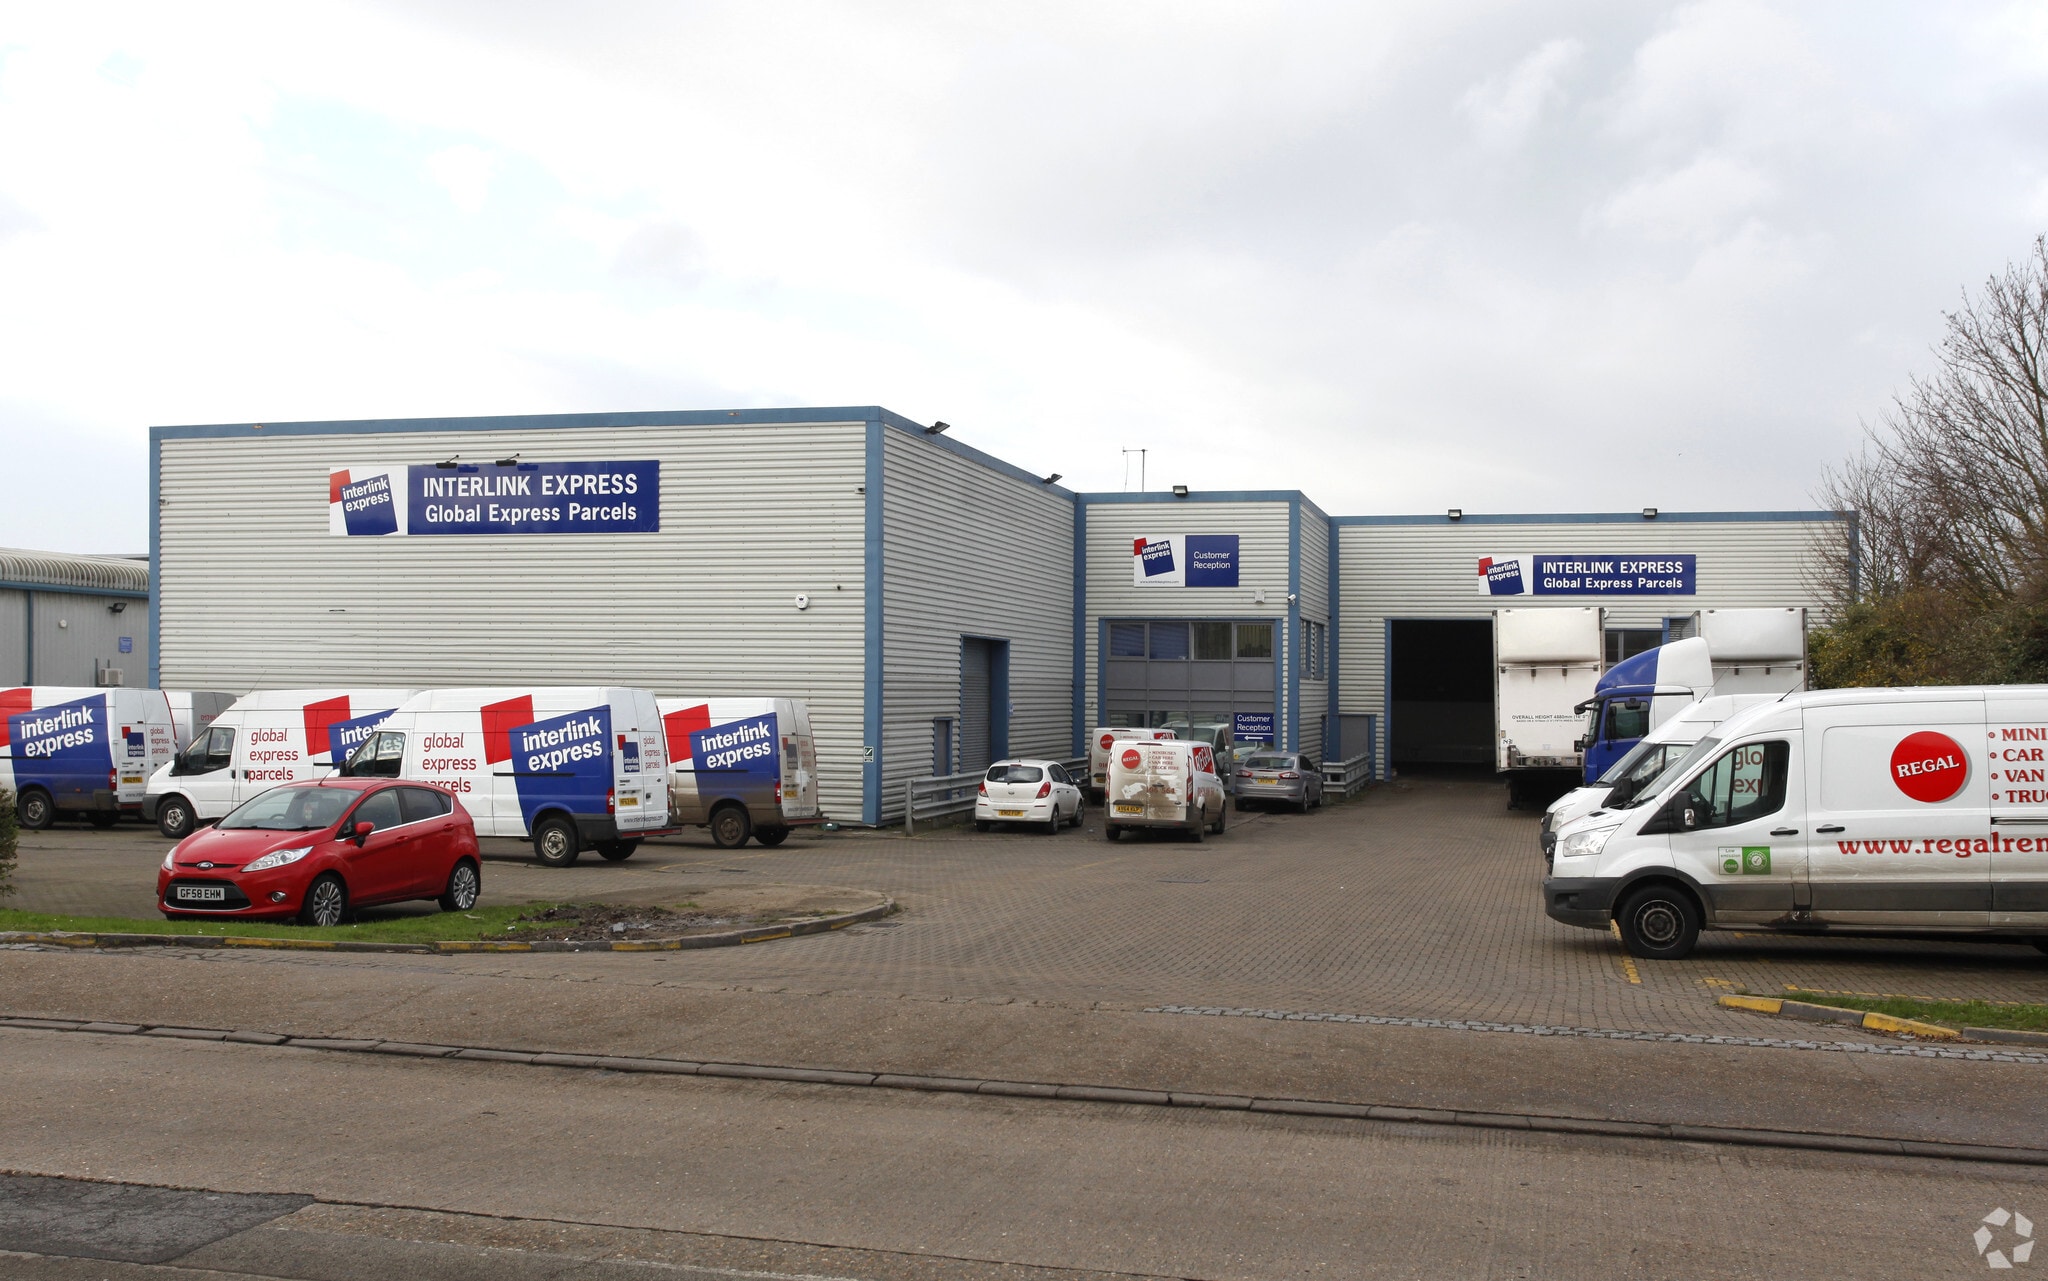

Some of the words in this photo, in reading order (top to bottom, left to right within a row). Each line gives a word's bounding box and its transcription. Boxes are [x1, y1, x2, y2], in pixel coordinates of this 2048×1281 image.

[342, 477, 389, 500] interlink
[423, 475, 531, 498] INTERLINK
[541, 473, 638, 496] EXPRESS
[345, 492, 390, 512] express
[425, 503, 480, 523] Global
[488, 503, 561, 526] Express
[568, 501, 637, 521] Parcels
[1141, 541, 1170, 555] interlink
[1143, 550, 1171, 561] express
[1193, 551, 1231, 560] Customer
[1193, 561, 1231, 570] Reception
[1486, 561, 1519, 575] interlink
[1542, 561, 1614, 574] INTERLINK
[1620, 561, 1684, 574] EXPRESS
[1489, 570, 1520, 581] express
[1543, 577, 1581, 589] Global
[1585, 577, 1633, 590] Express
[1637, 577, 1683, 588] Parcels
[20, 704, 94, 740] interlink
[1236, 714, 1271, 722] Customer
[149, 726, 165, 736] global
[522, 715, 603, 753] interlink
[1236, 723, 1271, 733] Reception
[25, 728, 94, 757] express
[150, 738, 170, 746] express
[251, 728, 288, 746] global
[423, 732, 464, 753] global
[700, 721, 771, 753] interlink
[151, 746, 169, 755] parcels
[249, 750, 299, 765] express
[528, 740, 603, 772] express
[706, 741, 771, 769] express
[2003, 748, 2045, 762] CAR
[422, 758, 477, 775] express
[1896, 755, 1960, 778] REGAL
[248, 766, 294, 784] parcels
[2004, 769, 2045, 783] VAN
[2005, 789, 2048, 803] TRU
[1837, 831, 2048, 859] www.regalren
[180, 888, 203, 898] GF58
